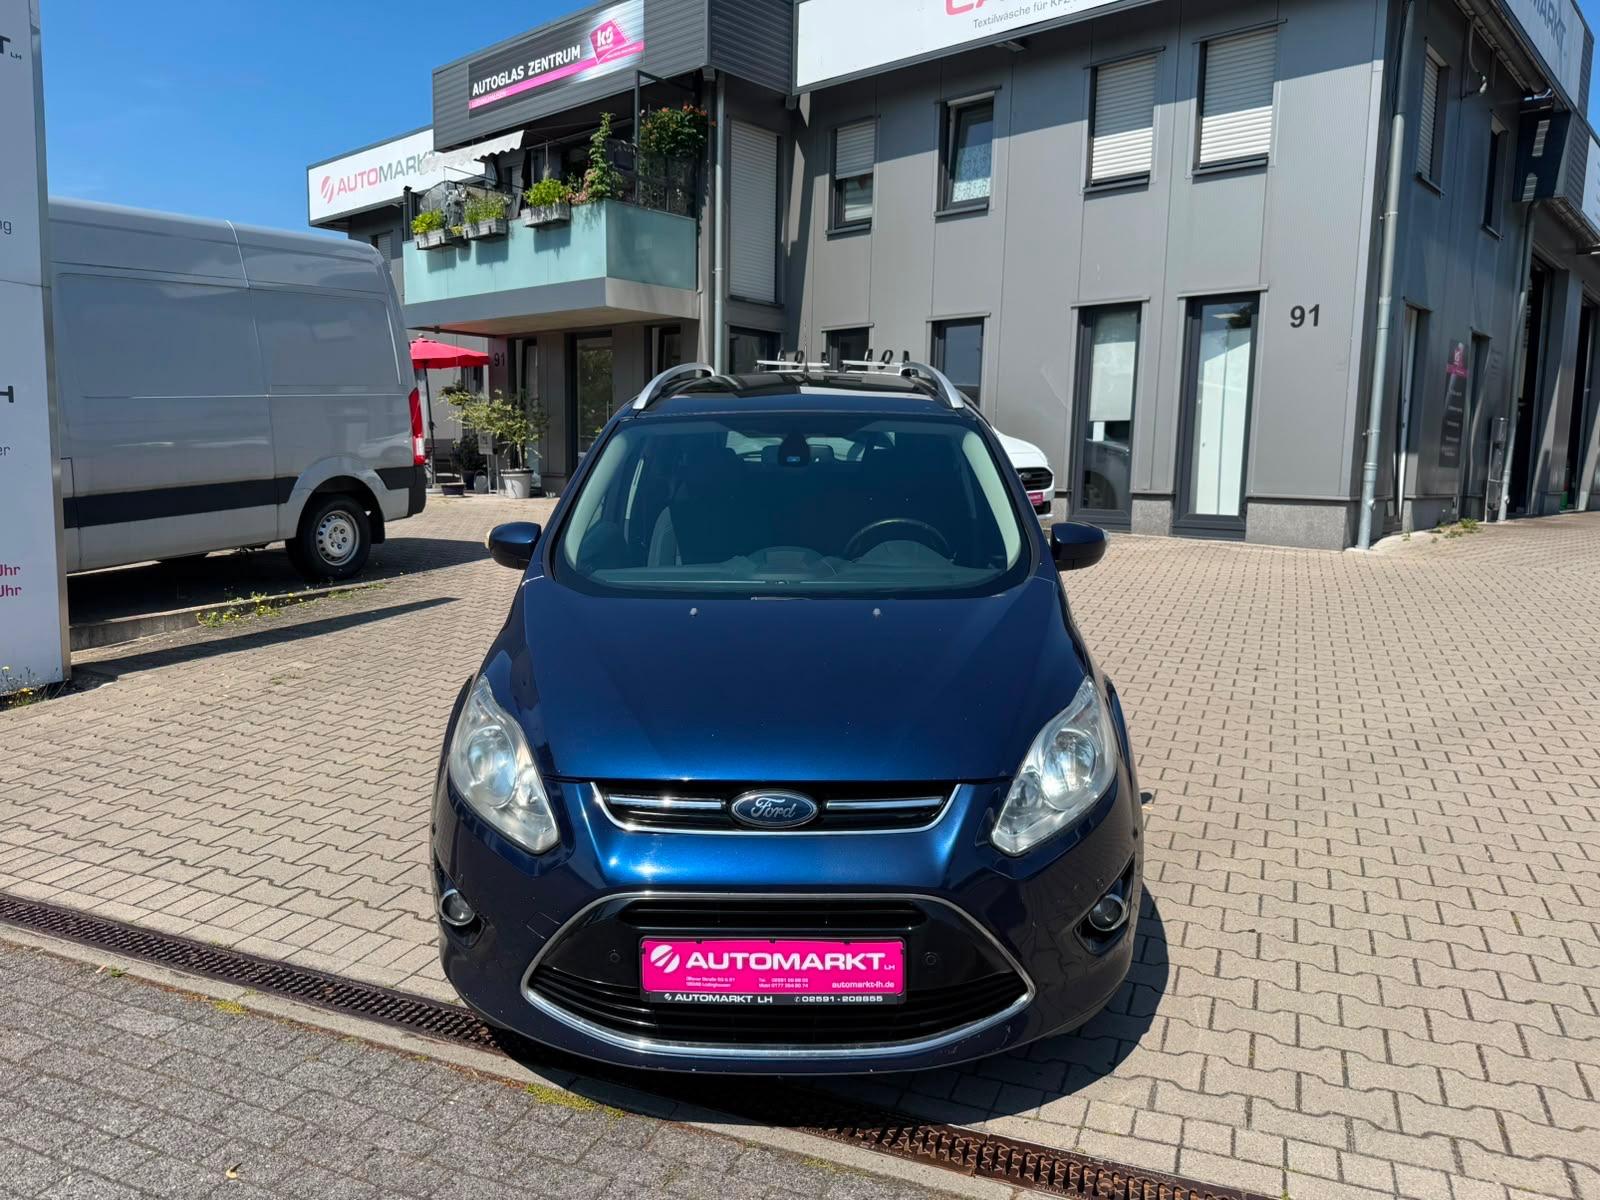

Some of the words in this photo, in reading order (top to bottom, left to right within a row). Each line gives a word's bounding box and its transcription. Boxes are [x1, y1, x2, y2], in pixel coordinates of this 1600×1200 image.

[471, 65, 525, 97] AUTOGLAS
[527, 44, 581, 76] ZENTRUM
[337, 150, 436, 196] AUTOMARK
[1290, 303, 1320, 328] 91
[494, 352, 505, 367] 91
[751, 797, 797, 818] Ford
[685, 952, 887, 971] AUTOMARKT
[831, 980, 895, 989] automarkt-lh.de
[674, 993, 754, 1003] AUTOMARKT
[757, 995, 773, 1004] LH
